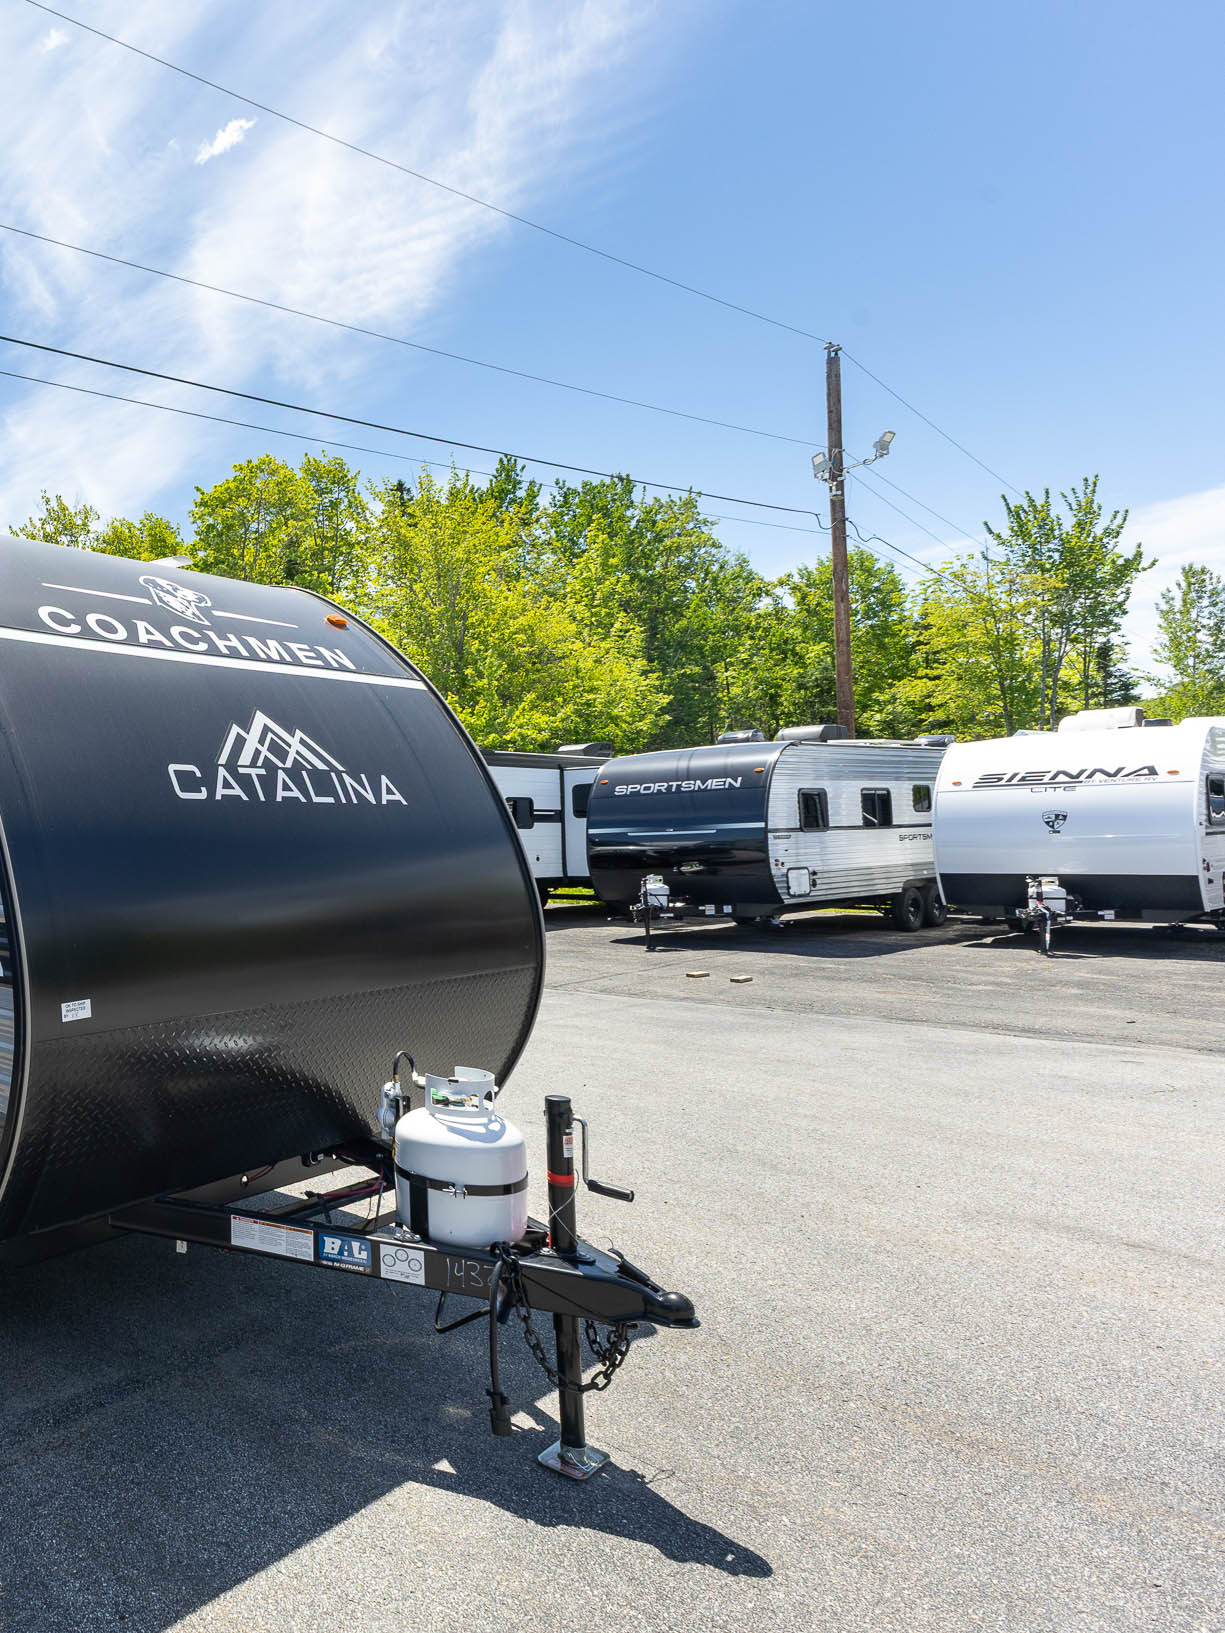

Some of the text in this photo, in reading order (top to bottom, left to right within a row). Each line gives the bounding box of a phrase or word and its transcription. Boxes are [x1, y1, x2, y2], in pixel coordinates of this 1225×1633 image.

[37, 605, 356, 670] COACHMEN
[167, 763, 408, 806] CATALINA
[974, 765, 1160, 784] SIENNA
[614, 776, 742, 796] SPORTSMEN
[1030, 785, 1078, 793] LITE
[323, 1236, 367, 1259] BAL
